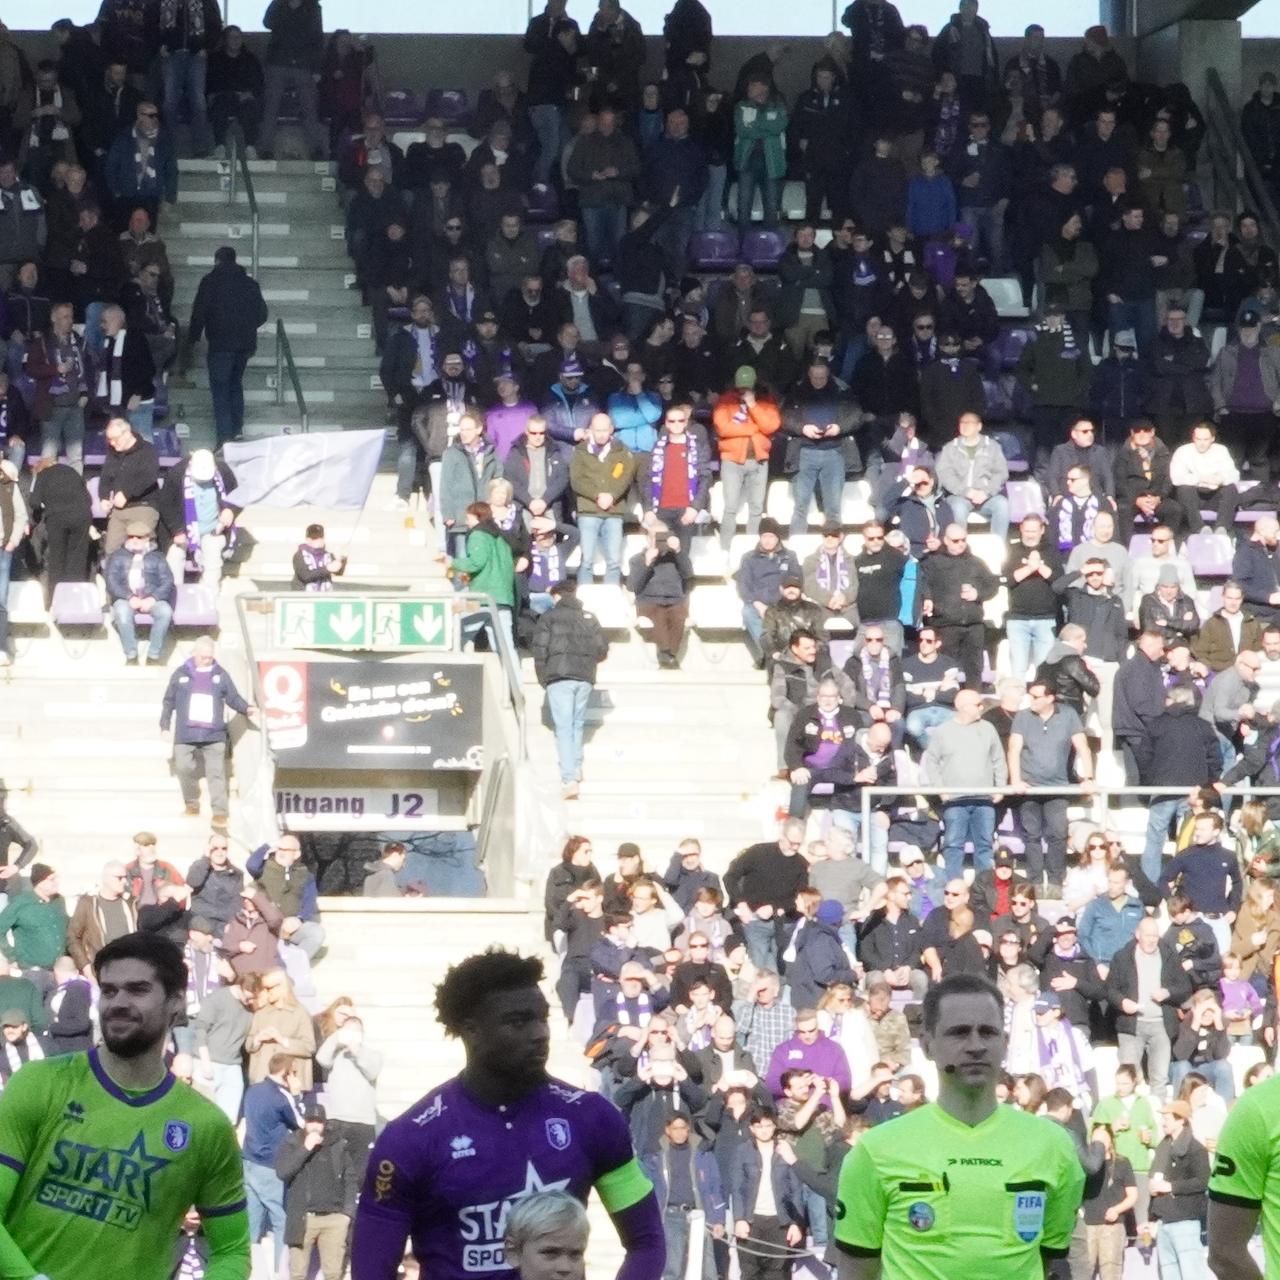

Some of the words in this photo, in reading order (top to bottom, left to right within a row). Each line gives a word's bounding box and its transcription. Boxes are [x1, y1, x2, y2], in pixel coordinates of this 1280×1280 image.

[385, 793, 424, 818] J2
[48, 1139, 142, 1200] STAR
[960, 1158, 1004, 1167] PATRICK
[40, 1184, 109, 1216] SPORT
[115, 1204, 140, 1223] TV
[1017, 1196, 1042, 1208] FIFA
[458, 1200, 511, 1241] STA
[467, 1249, 505, 1267] SPO
